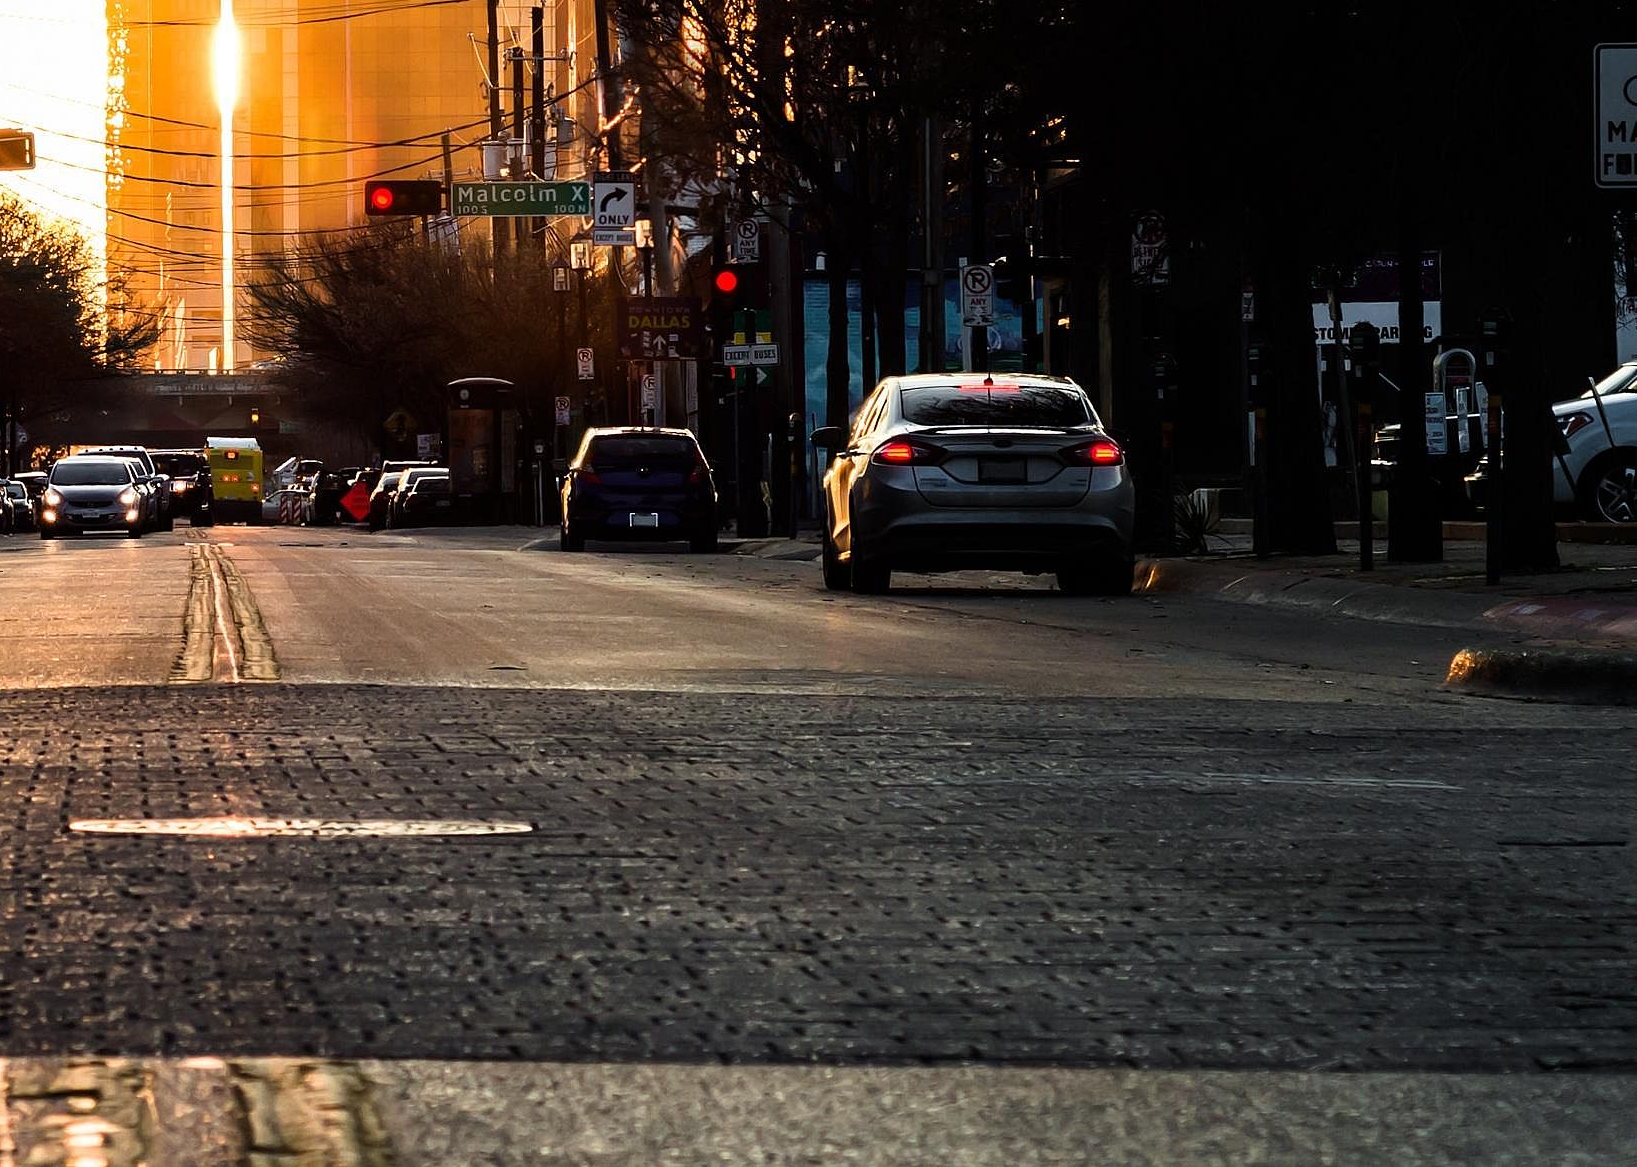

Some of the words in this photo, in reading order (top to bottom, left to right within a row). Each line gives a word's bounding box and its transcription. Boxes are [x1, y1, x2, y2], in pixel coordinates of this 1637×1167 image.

[458, 185, 557, 203] Malcolm
[571, 186, 583, 202] X
[457, 206, 479, 214] 100
[554, 205, 576, 213] 100
[578, 205, 586, 213] N
[598, 214, 629, 225] ONLY
[628, 315, 691, 329] DALLAS
